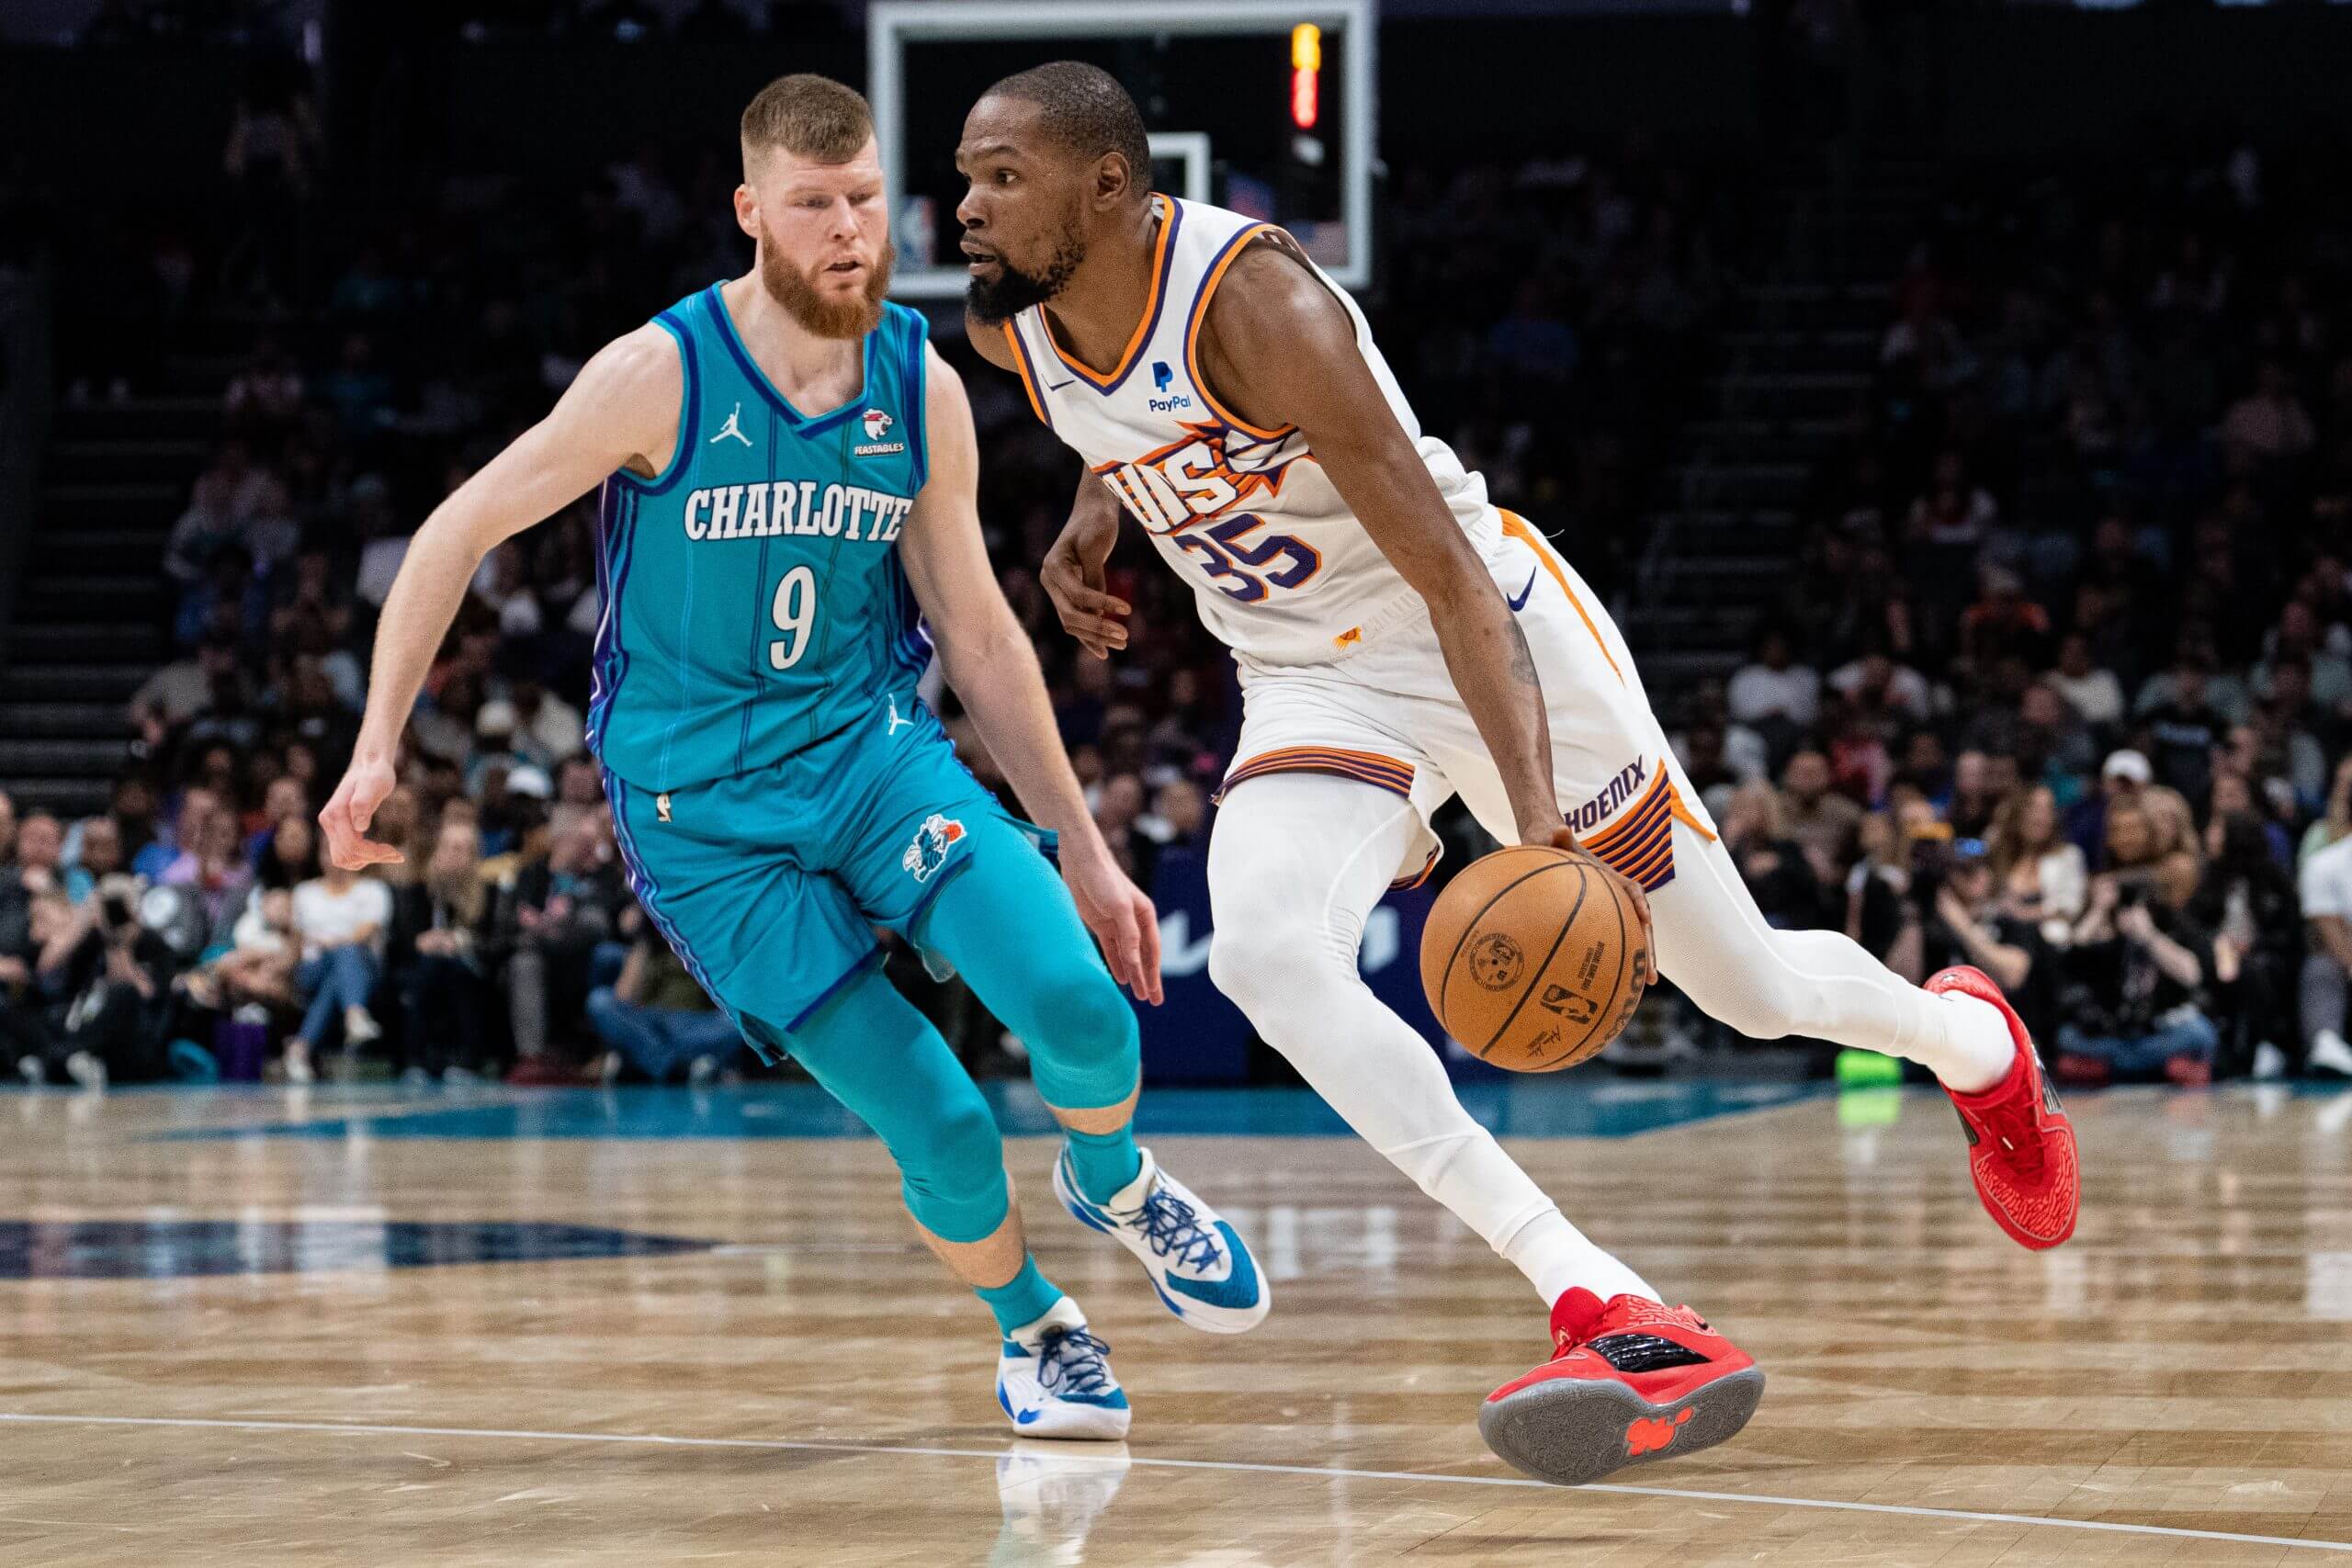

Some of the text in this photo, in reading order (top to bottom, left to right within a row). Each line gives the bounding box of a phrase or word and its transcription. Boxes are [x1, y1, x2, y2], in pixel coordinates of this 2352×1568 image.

[1148, 394, 1192, 412] PayPal
[854, 442, 904, 457] FEASTABLES
[684, 480, 915, 542] CHARLOTTE
[1173, 513, 1323, 604] 35
[770, 565, 817, 671] 9
[1564, 753, 1645, 834] HOENIX
